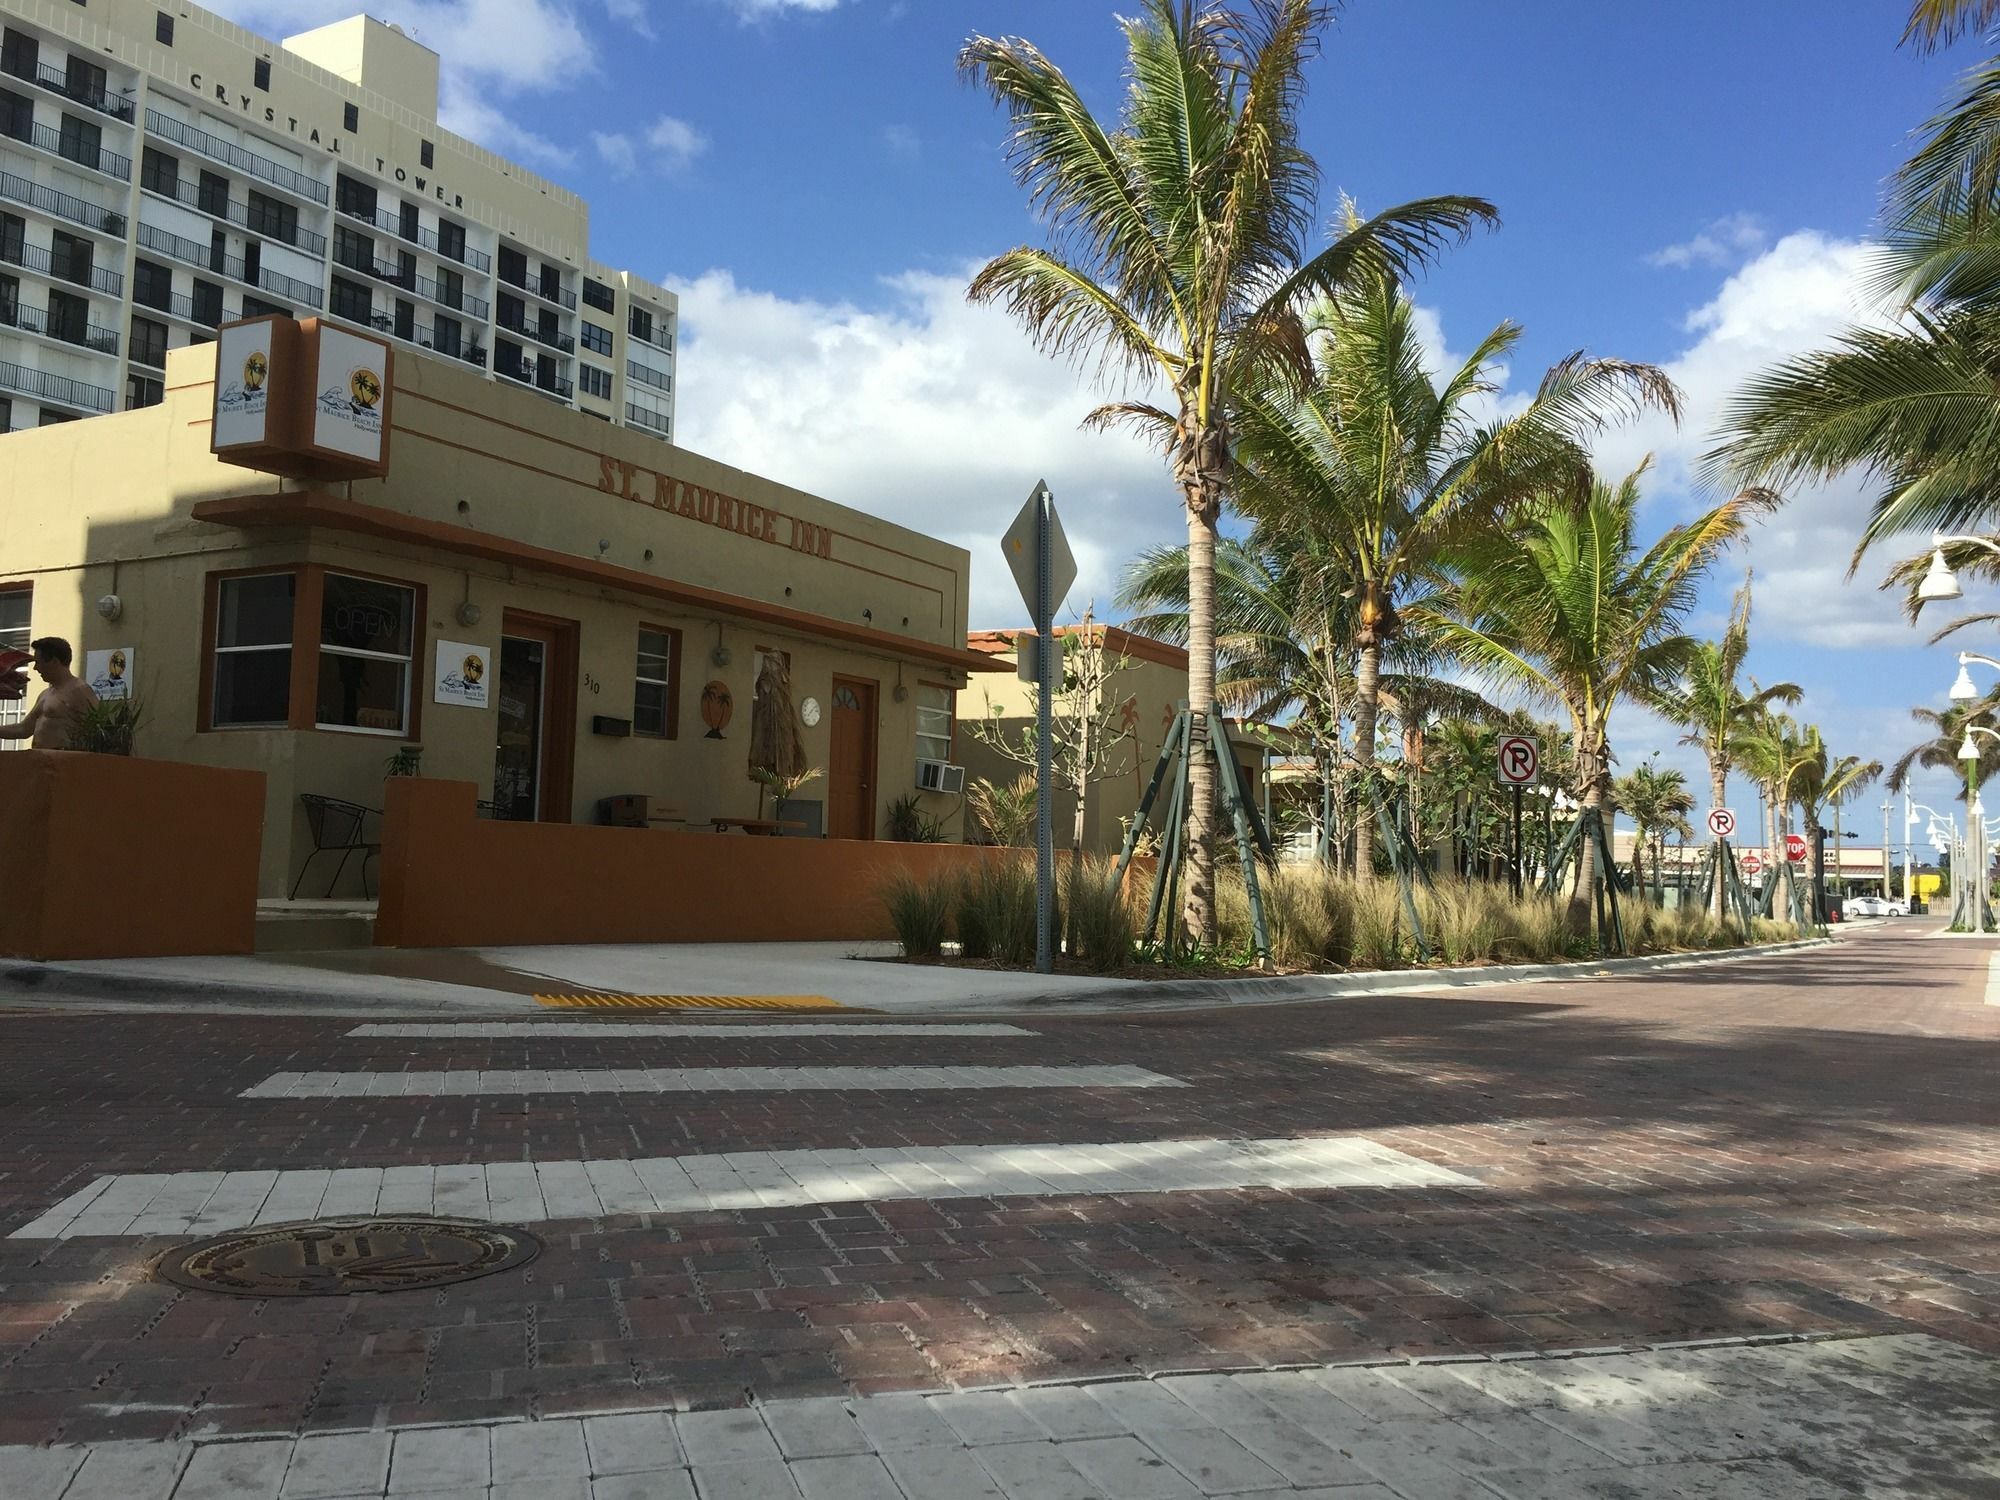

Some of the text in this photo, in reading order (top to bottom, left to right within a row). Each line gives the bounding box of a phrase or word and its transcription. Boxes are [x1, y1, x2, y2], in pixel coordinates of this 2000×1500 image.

[190, 73, 464, 209] CRYSTAL TOWER
[598, 455, 833, 559] ST. MAURICE INN
[335, 606, 397, 640] OPEN
[584, 673, 600, 695] 310
[1786, 842, 1805, 854] TOP
